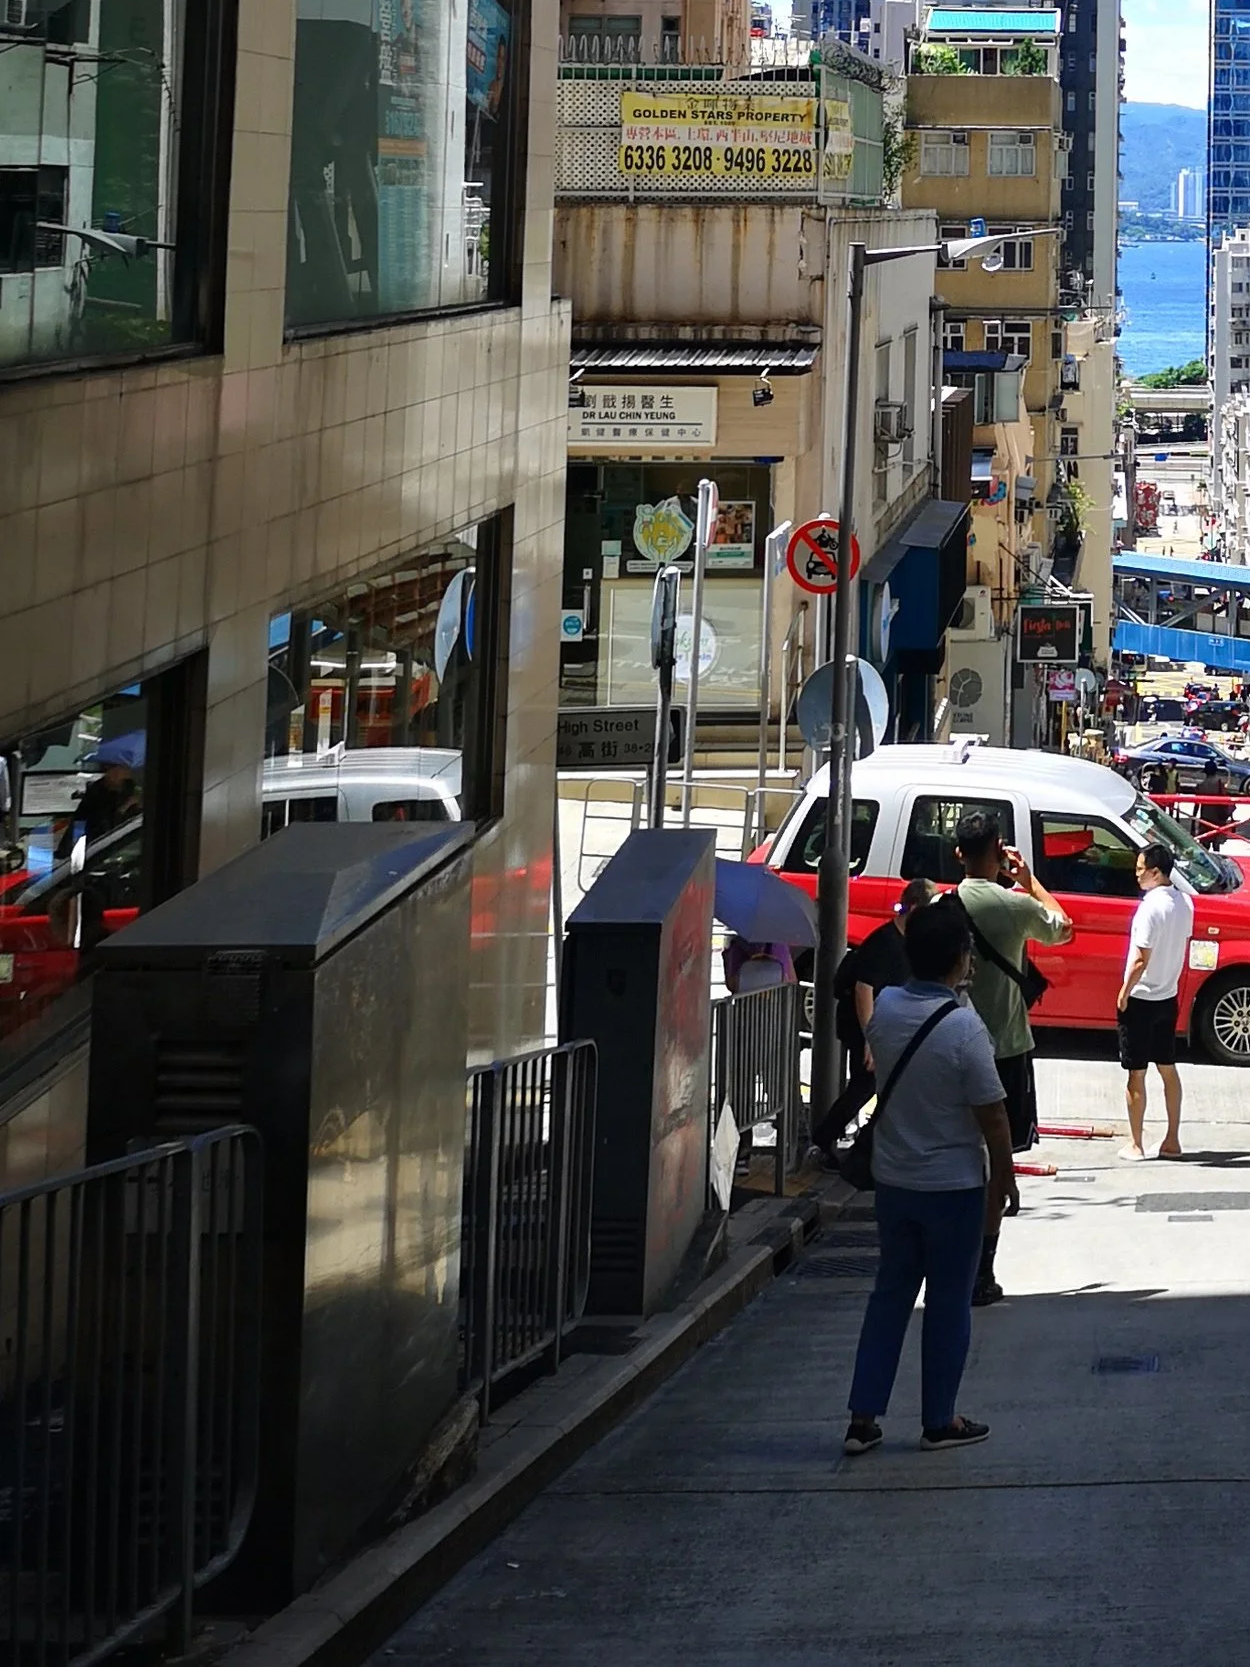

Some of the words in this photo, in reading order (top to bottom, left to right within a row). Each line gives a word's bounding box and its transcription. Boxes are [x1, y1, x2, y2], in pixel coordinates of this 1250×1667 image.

[633, 109, 686, 120] GOLDEN
[691, 110, 733, 121] STARS
[737, 112, 808, 123] PROPERTY
[624, 145, 666, 171] 6336
[671, 146, 713, 171] 3208
[724, 147, 766, 172] 9496
[771, 149, 813, 173] 3228
[582, 411, 596, 420] DR
[598, 411, 617, 420] LAU
[619, 411, 642, 420] CHIN
[644, 411, 676, 420] YEUNG
[558, 720, 588, 736] High
[593, 718, 640, 732] Street
[578, 740, 618, 759] 高街
